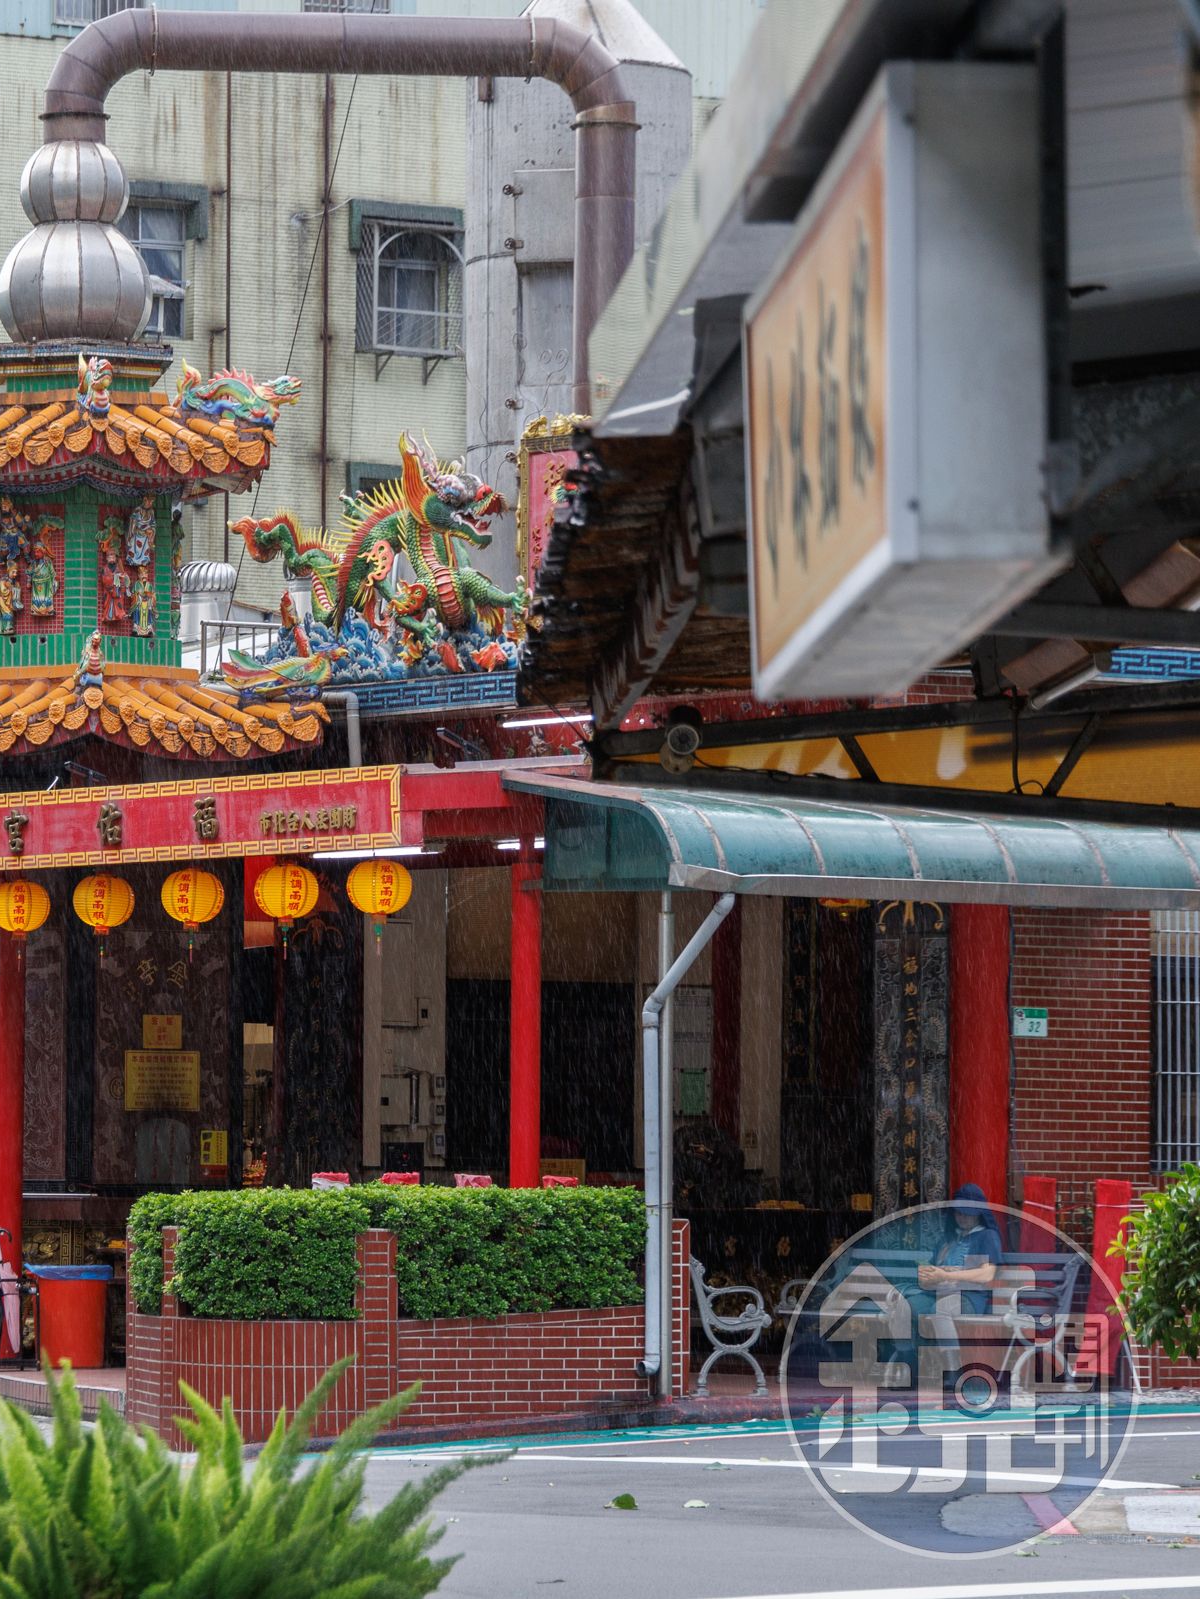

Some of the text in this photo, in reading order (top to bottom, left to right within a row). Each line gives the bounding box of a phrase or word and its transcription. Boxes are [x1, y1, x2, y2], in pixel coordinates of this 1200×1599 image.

[4, 796, 357, 854] 財團法人台北市 福佑宮
[12, 885, 25, 925] 風調雨順
[92, 878, 106, 921] 風調雨順
[177, 872, 191, 914] 風調雨順
[287, 868, 303, 911] 風調雨順
[379, 864, 393, 908] 風調雨順
[1028, 1021, 1041, 1033] 32
